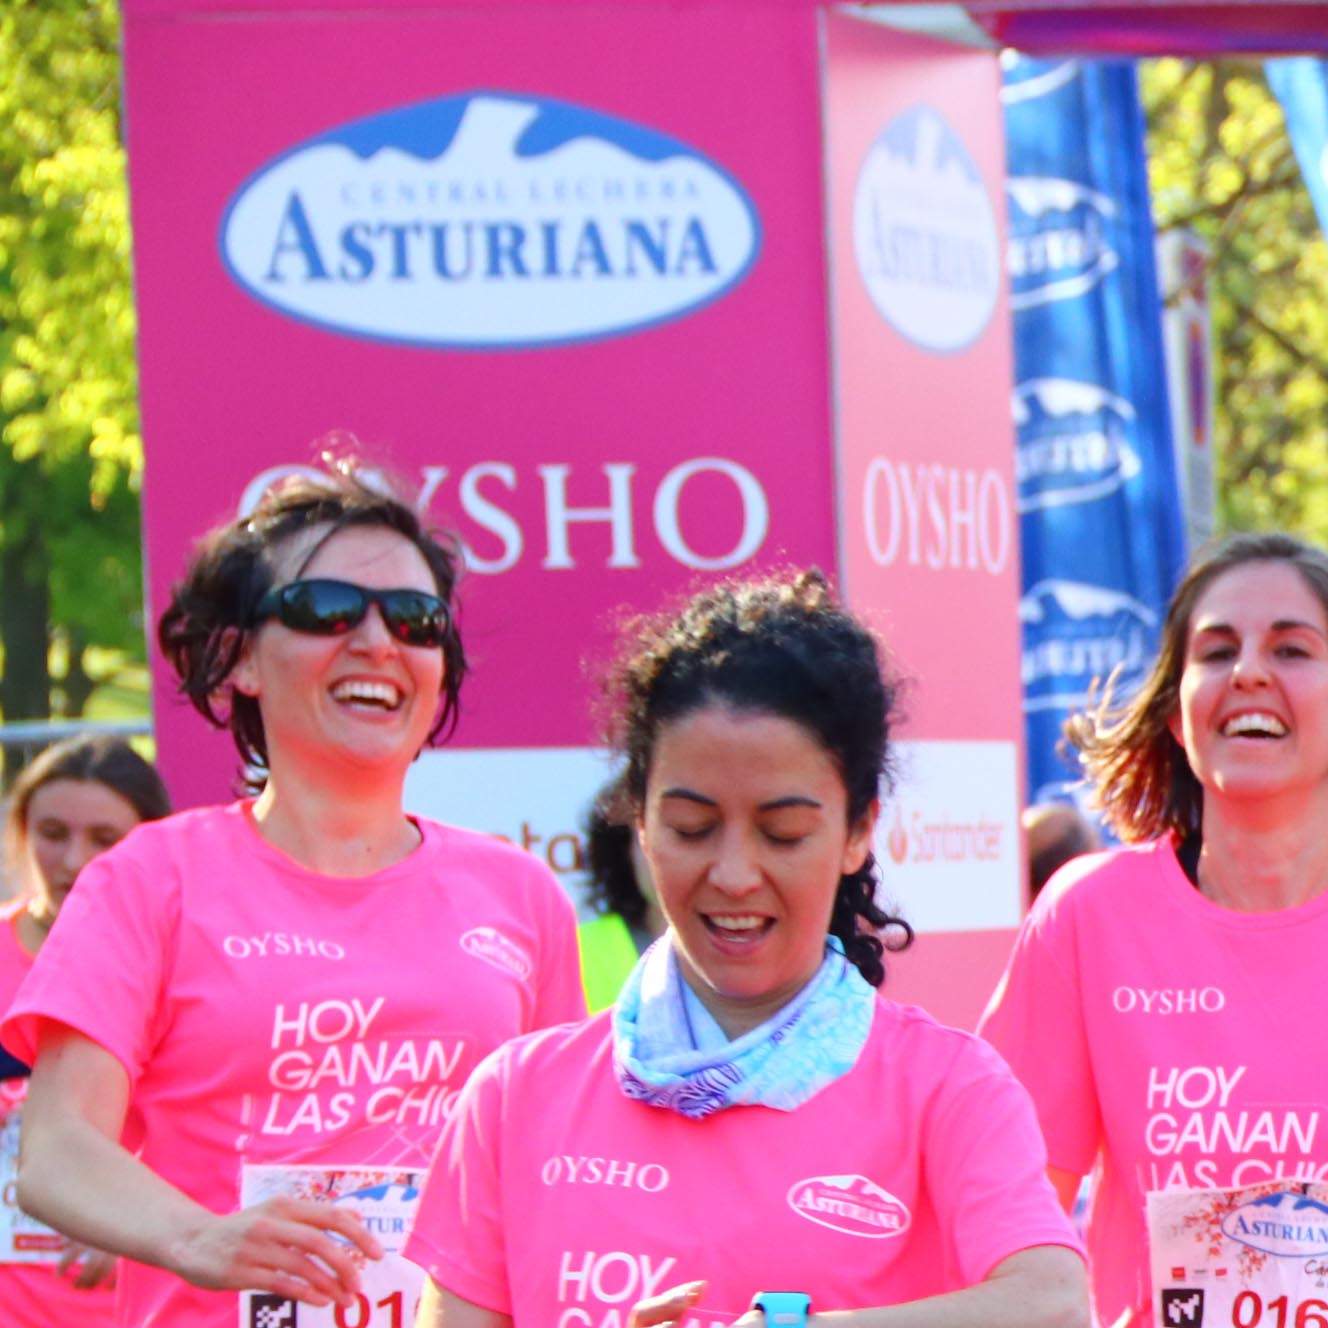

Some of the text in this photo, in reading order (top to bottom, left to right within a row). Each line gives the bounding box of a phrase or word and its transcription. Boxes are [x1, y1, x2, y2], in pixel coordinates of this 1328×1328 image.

[262, 189, 718, 284] ASTURIANA
[237, 458, 770, 574] SHO
[862, 455, 1010, 576] OYSHO
[223, 933, 345, 960] OYSHO
[271, 996, 386, 1049] HOY
[1112, 986, 1226, 1015] OYSHO
[268, 1038, 465, 1092] GANAN
[1146, 1066, 1248, 1109] HOY
[261, 1092, 356, 1136] LAS
[1145, 1111, 1320, 1156] GANAN
[541, 1155, 671, 1193] OYSHO
[556, 1250, 677, 1304] HOY
